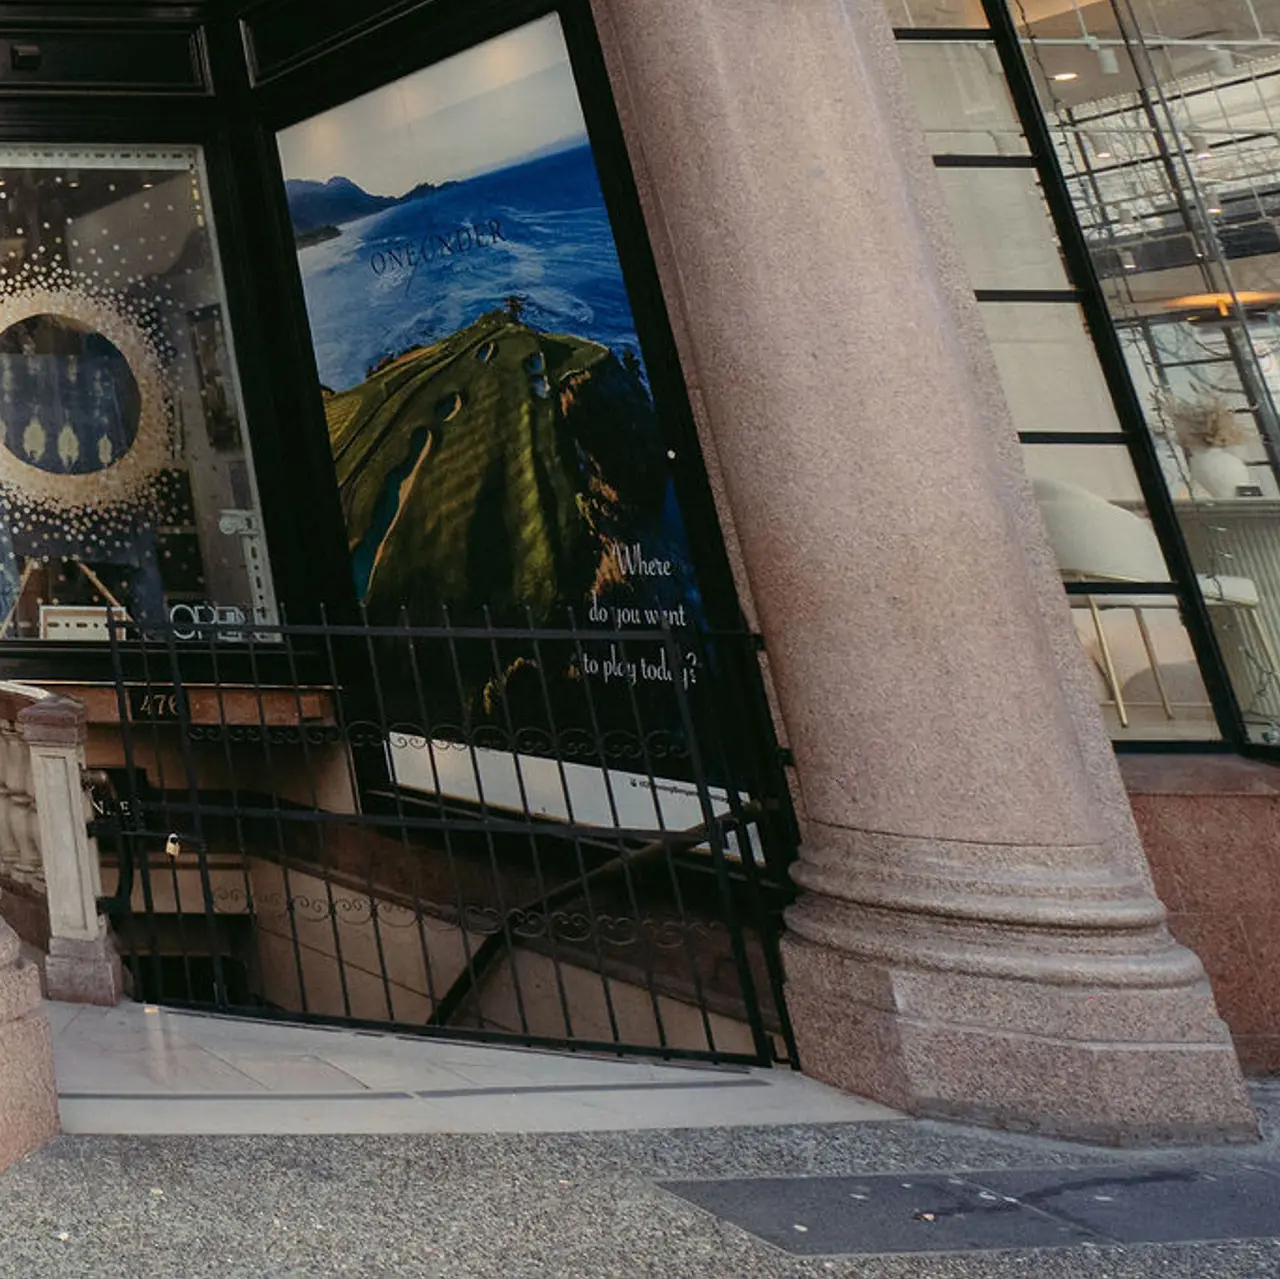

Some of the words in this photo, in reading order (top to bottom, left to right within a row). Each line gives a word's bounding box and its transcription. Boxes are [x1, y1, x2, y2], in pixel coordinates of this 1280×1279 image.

[612, 538, 672, 576] Where
[589, 589, 608, 622] do
[583, 652, 599, 674] to
